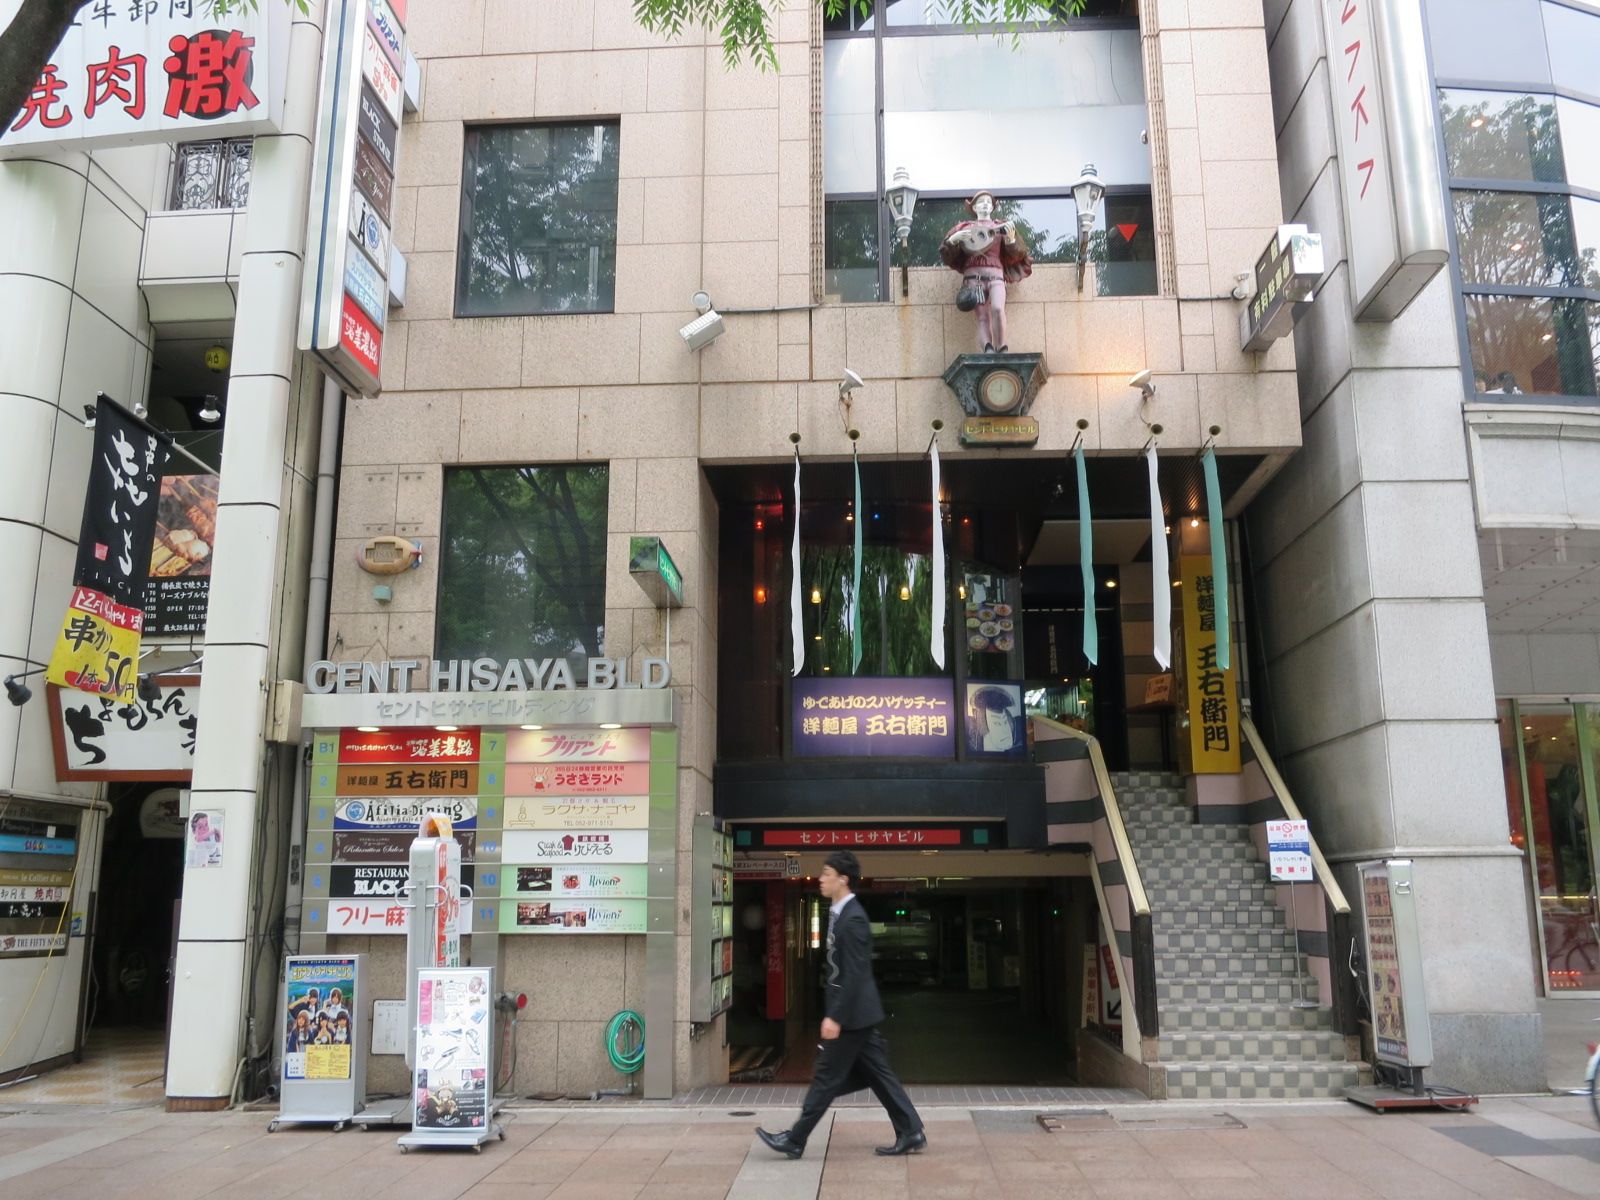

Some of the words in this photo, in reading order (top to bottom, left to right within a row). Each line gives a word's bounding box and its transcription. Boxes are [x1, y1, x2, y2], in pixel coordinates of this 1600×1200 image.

[362, 95, 382, 133] BLACK
[372, 128, 392, 164] STONE
[306, 658, 420, 694] CENT
[432, 656, 577, 692] HISAYA
[587, 655, 673, 691] BLD
[376, 696, 597, 719] セントヒサヤビルディング
[802, 694, 947, 710] ゆであげのスパゲッティー
[1197, 645, 1231, 752] 五右衛門
[802, 716, 858, 736] 洋麺屋
[865, 714, 948, 737] 五右衛門
[319, 742, 335, 754] B1
[489, 740, 497, 751] 7
[320, 775, 329, 787] 2
[384, 769, 469, 790] 五右衛門
[799, 830, 925, 844] セント・ヒサヤビル
[353, 879, 400, 896] BLACK
[18, 938, 29, 948] THE
